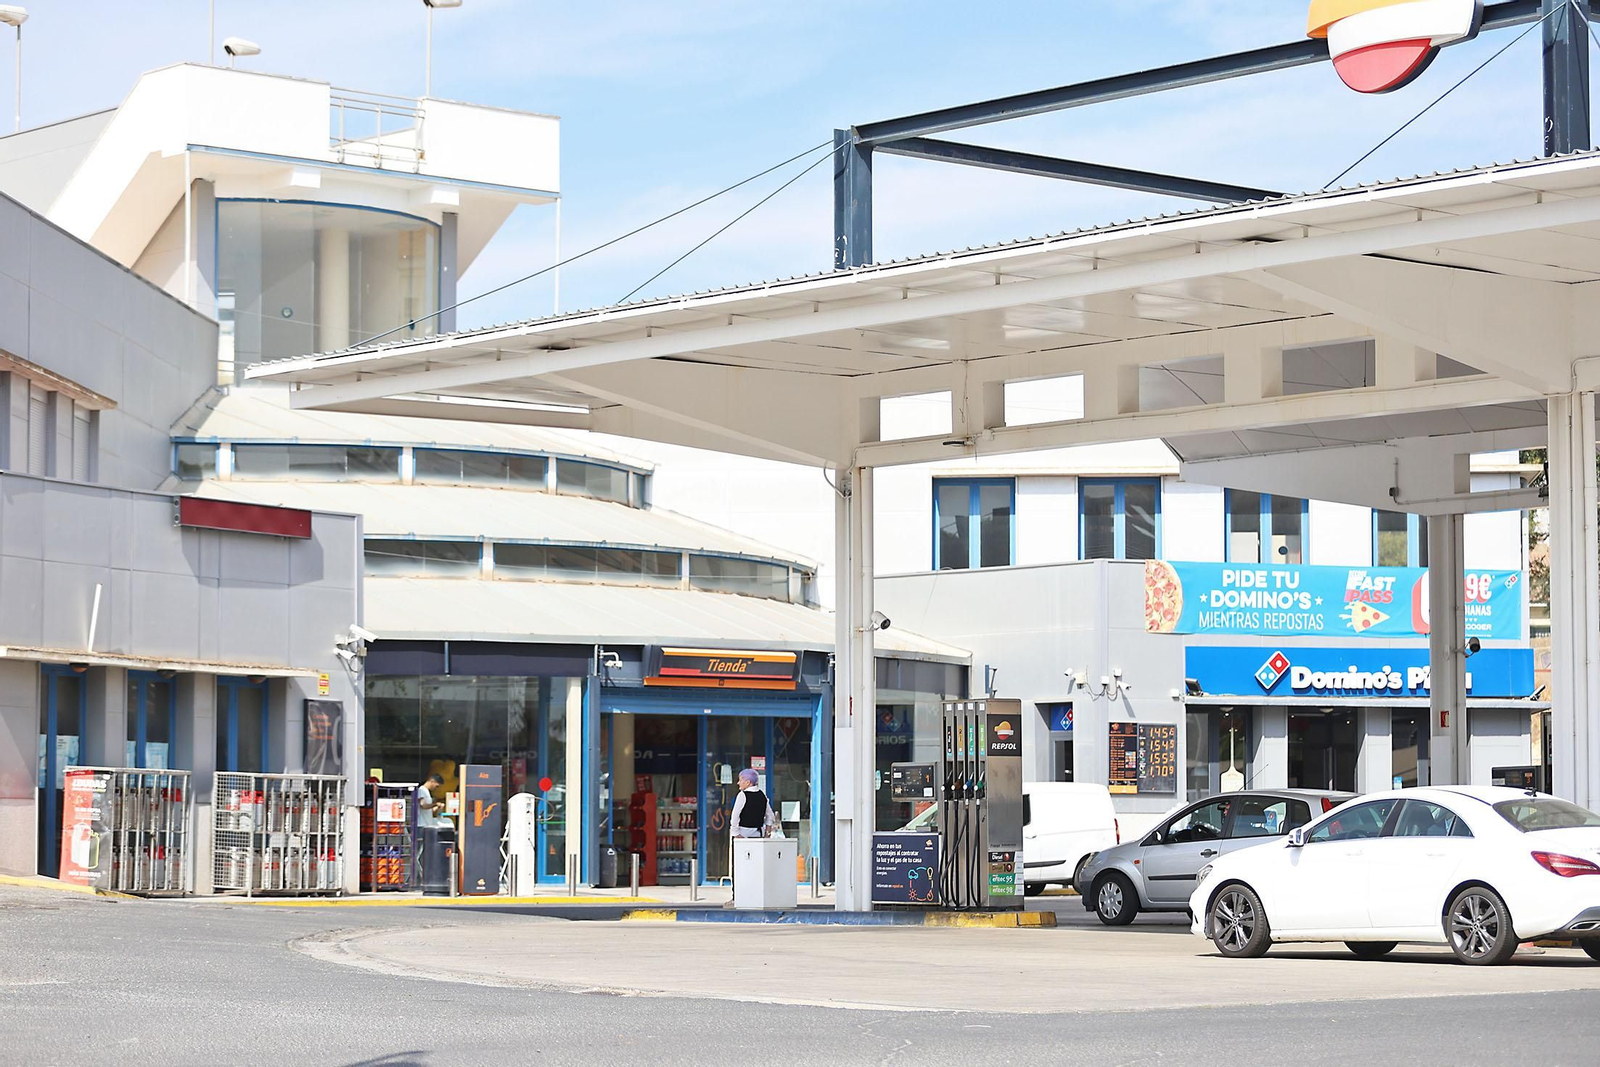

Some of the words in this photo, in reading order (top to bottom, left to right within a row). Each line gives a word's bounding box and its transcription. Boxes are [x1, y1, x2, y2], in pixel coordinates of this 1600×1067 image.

[1222, 569, 1267, 588] PIDE
[1272, 570, 1300, 589] TU
[1348, 576, 1396, 591] FAST
[1210, 589, 1312, 610] DOMINO'S
[1346, 589, 1394, 604] PASS
[1199, 611, 1260, 629] MIENTRAS
[1263, 612, 1324, 631] REPOSTAS
[1290, 665, 1403, 690] Domino's
[991, 742, 1017, 750] REPSOL
